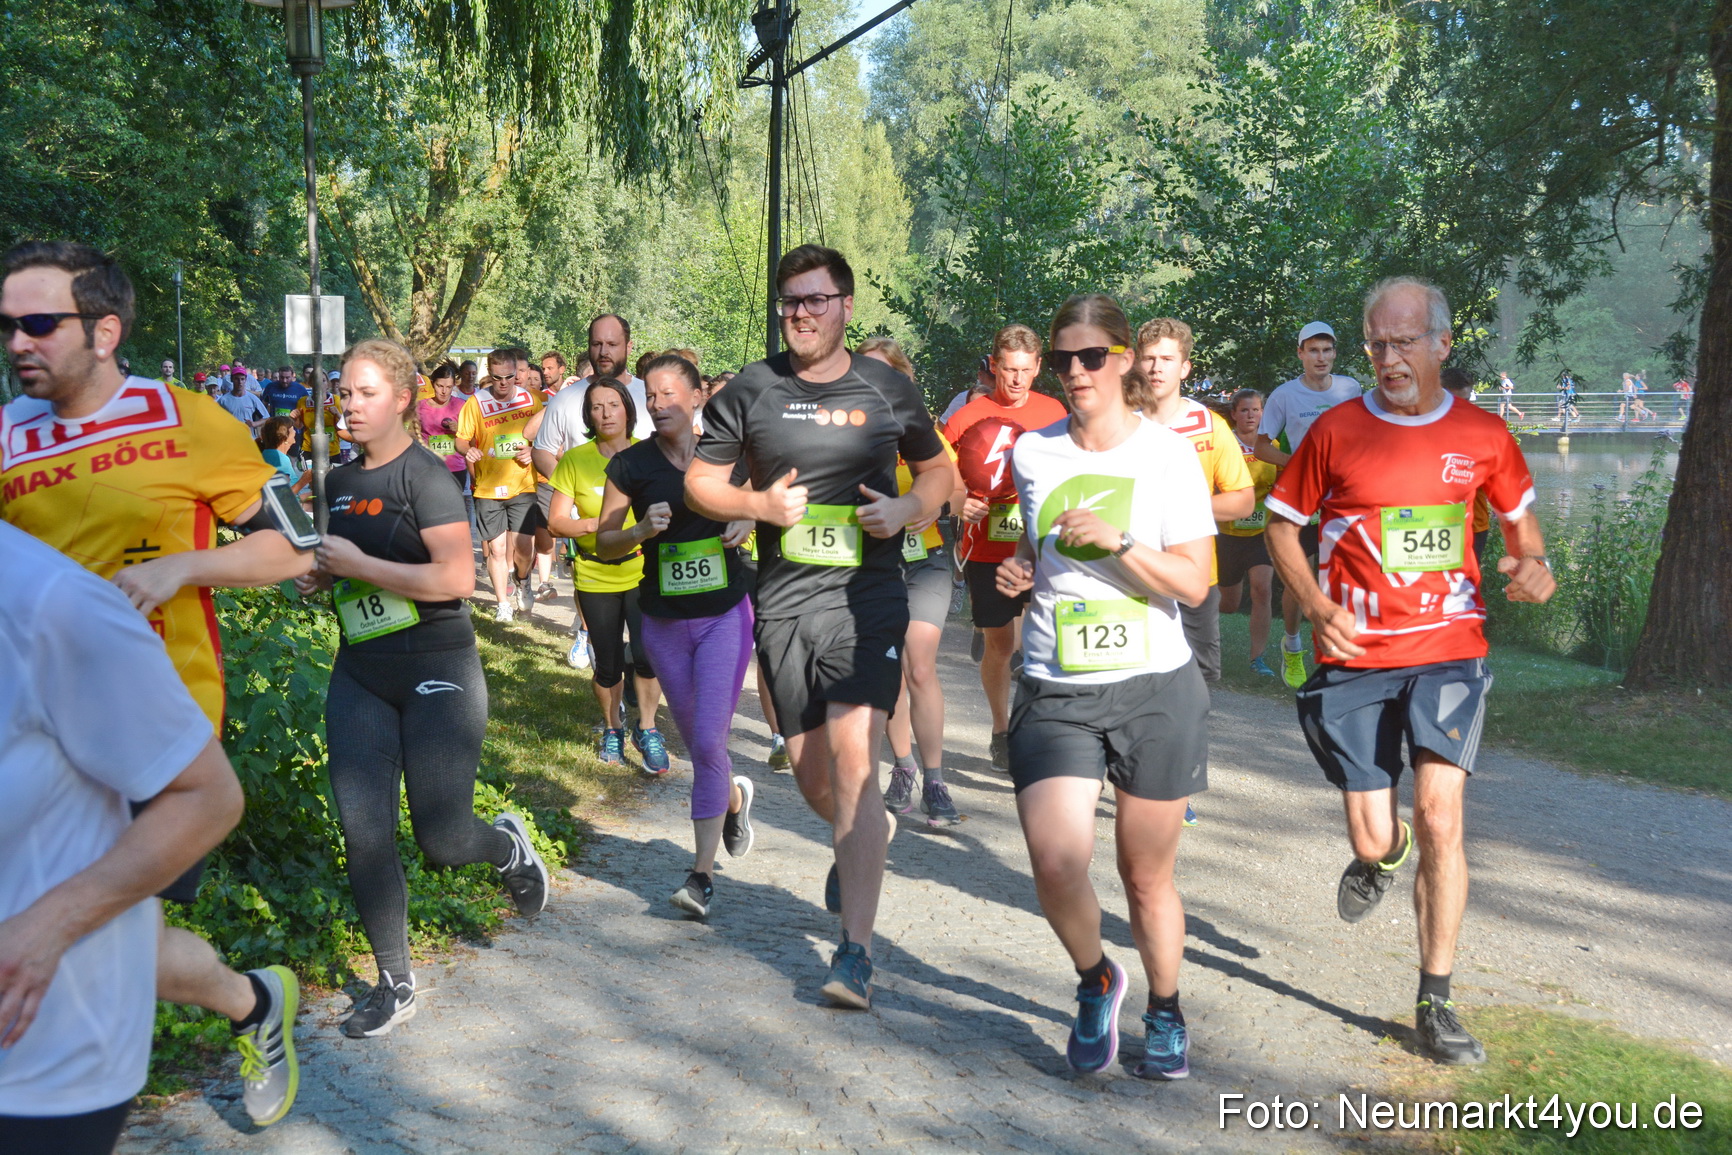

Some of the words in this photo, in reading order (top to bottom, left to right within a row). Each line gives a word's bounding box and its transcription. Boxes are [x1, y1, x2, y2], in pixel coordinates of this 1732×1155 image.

[484, 416, 509, 428] MAX
[511, 409, 535, 421] BÖGL
[782, 412, 807, 420] Running
[431, 441, 452, 450] 1441
[2, 463, 78, 504] MAX
[91, 439, 188, 474] BÖGL
[1240, 511, 1264, 522] 96
[806, 526, 836, 547] 15
[1403, 529, 1451, 553] 548
[671, 558, 711, 581] 856
[357, 594, 385, 621] 18
[377, 616, 392, 624] Lena
[1077, 624, 1128, 650] 123
